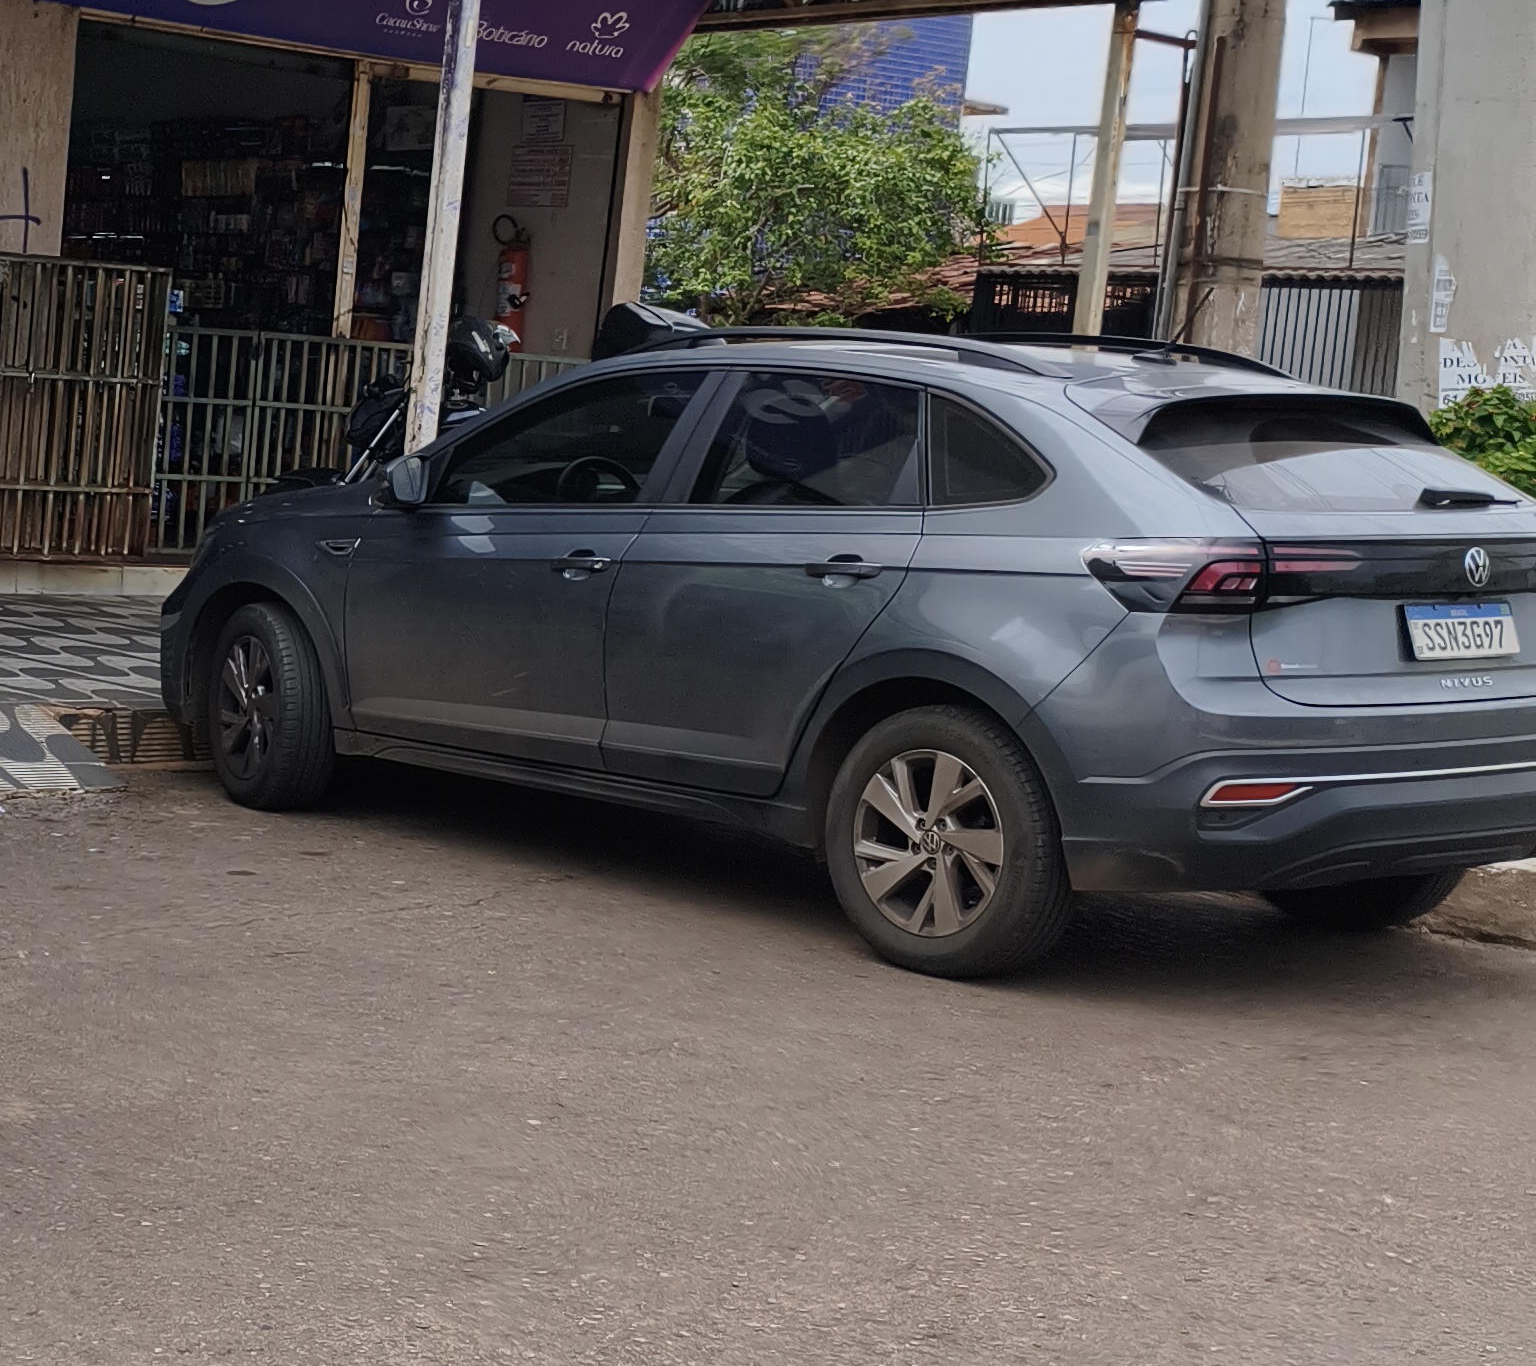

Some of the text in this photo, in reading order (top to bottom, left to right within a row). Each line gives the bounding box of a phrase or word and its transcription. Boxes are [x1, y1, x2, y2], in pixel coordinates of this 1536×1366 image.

[565, 38, 624, 59] natura
[1421, 619, 1505, 653] SSN3G97
[1440, 675, 1494, 690] NIVUS
